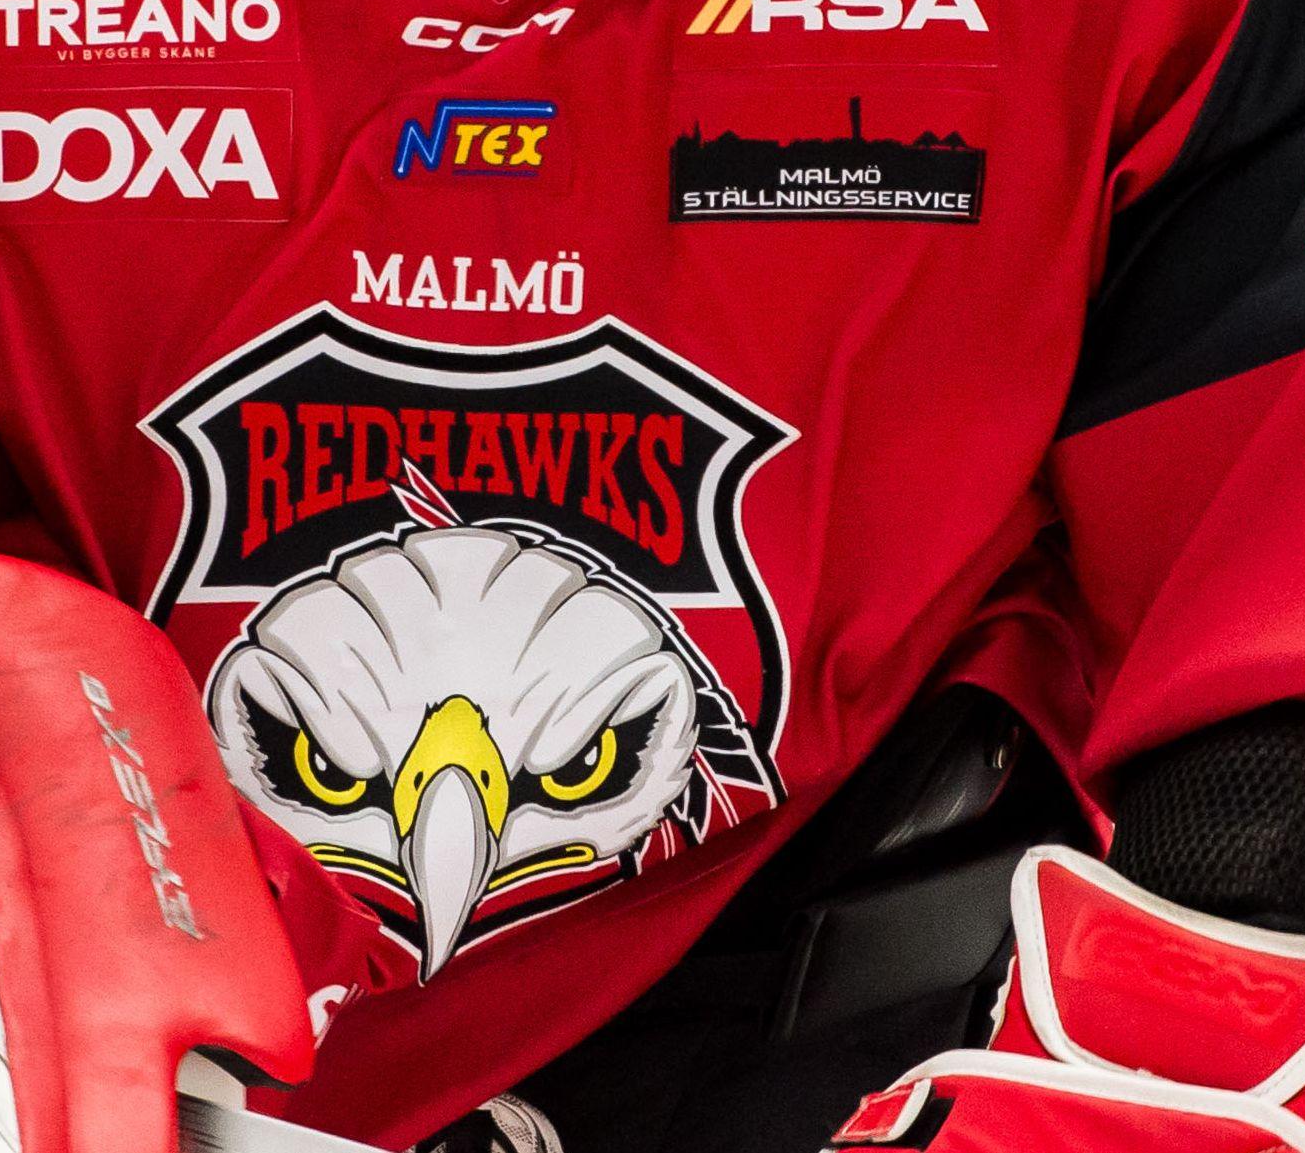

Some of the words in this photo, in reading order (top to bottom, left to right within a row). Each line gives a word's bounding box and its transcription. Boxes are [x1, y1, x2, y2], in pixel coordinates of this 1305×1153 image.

[401, 7, 575, 53] CCM
[57, 50, 74, 61] VI
[82, 47, 151, 60] BYGGER
[779, 164, 882, 185] MALMÖ
[682, 186, 972, 210] STÄLLNINGSSERVICE
[350, 250, 585, 315] MALMÖ
[240, 401, 685, 568] REDHAWKS
